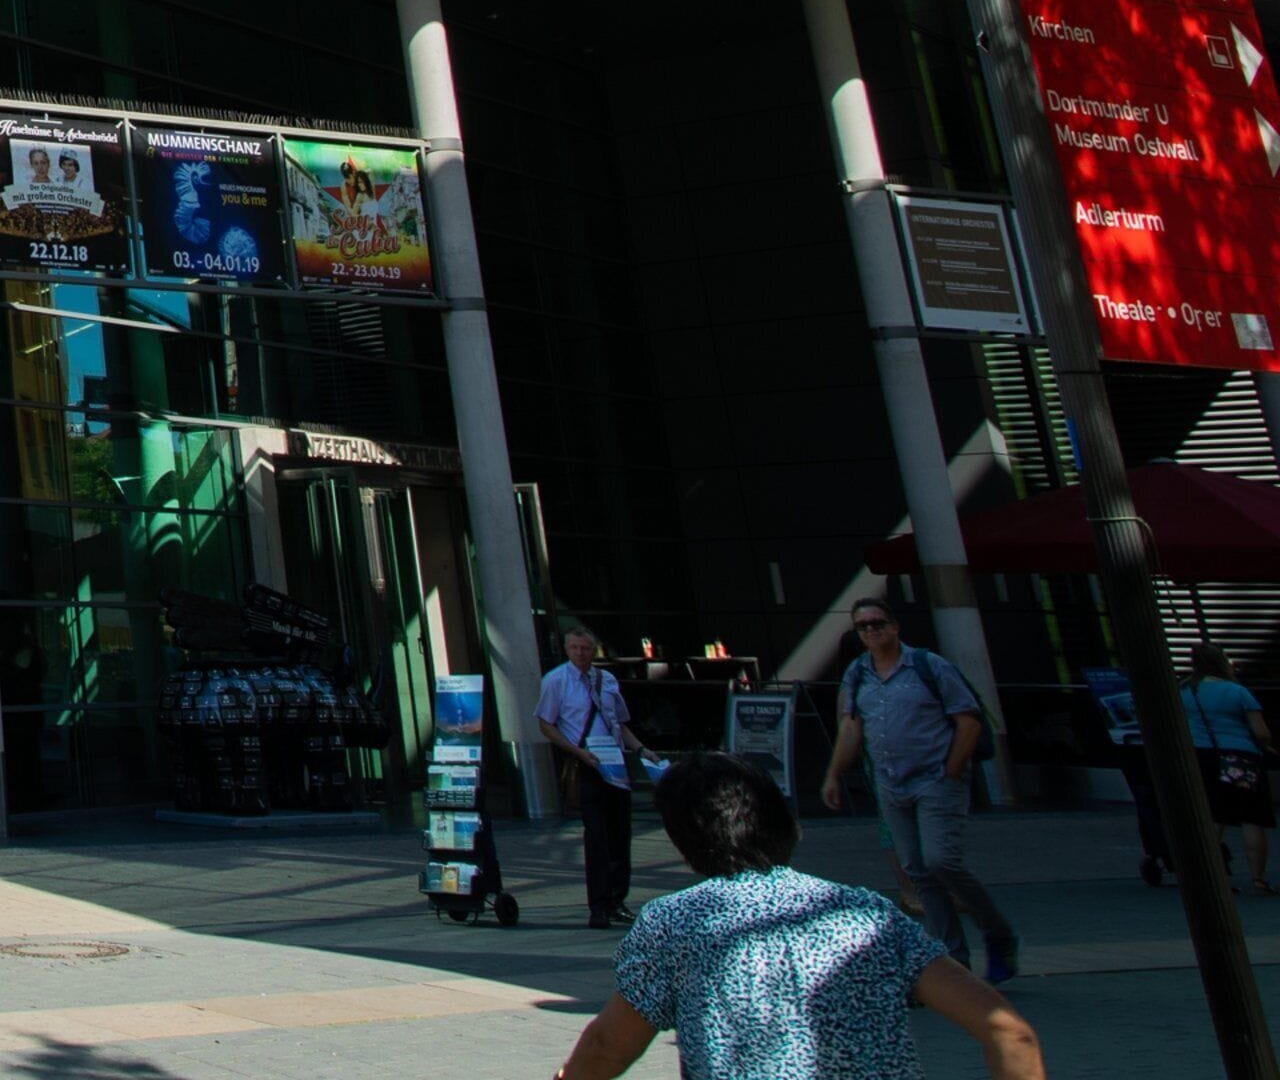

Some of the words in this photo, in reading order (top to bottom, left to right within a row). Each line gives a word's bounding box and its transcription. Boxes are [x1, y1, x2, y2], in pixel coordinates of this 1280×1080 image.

[1028, 15, 1096, 44] Kirchen
[1046, 89, 1150, 123] Dortmunder
[1154, 103, 1170, 125] U
[147, 133, 262, 156] MUMMENSCHANZ
[1054, 123, 1132, 154] Museum
[1133, 133, 1200, 162] Ostwall
[12, 193, 26, 203] mit
[27, 193, 56, 203] großem
[56, 193, 93, 207] Orchester
[221, 193, 241, 207] you
[241, 193, 251, 206] &
[250, 195, 268, 207] me
[1075, 201, 1166, 232] Adlerturm
[29, 241, 89, 262] 22.12.18
[339, 229, 400, 259] Cuba
[1093, 294, 1163, 322] Theate
